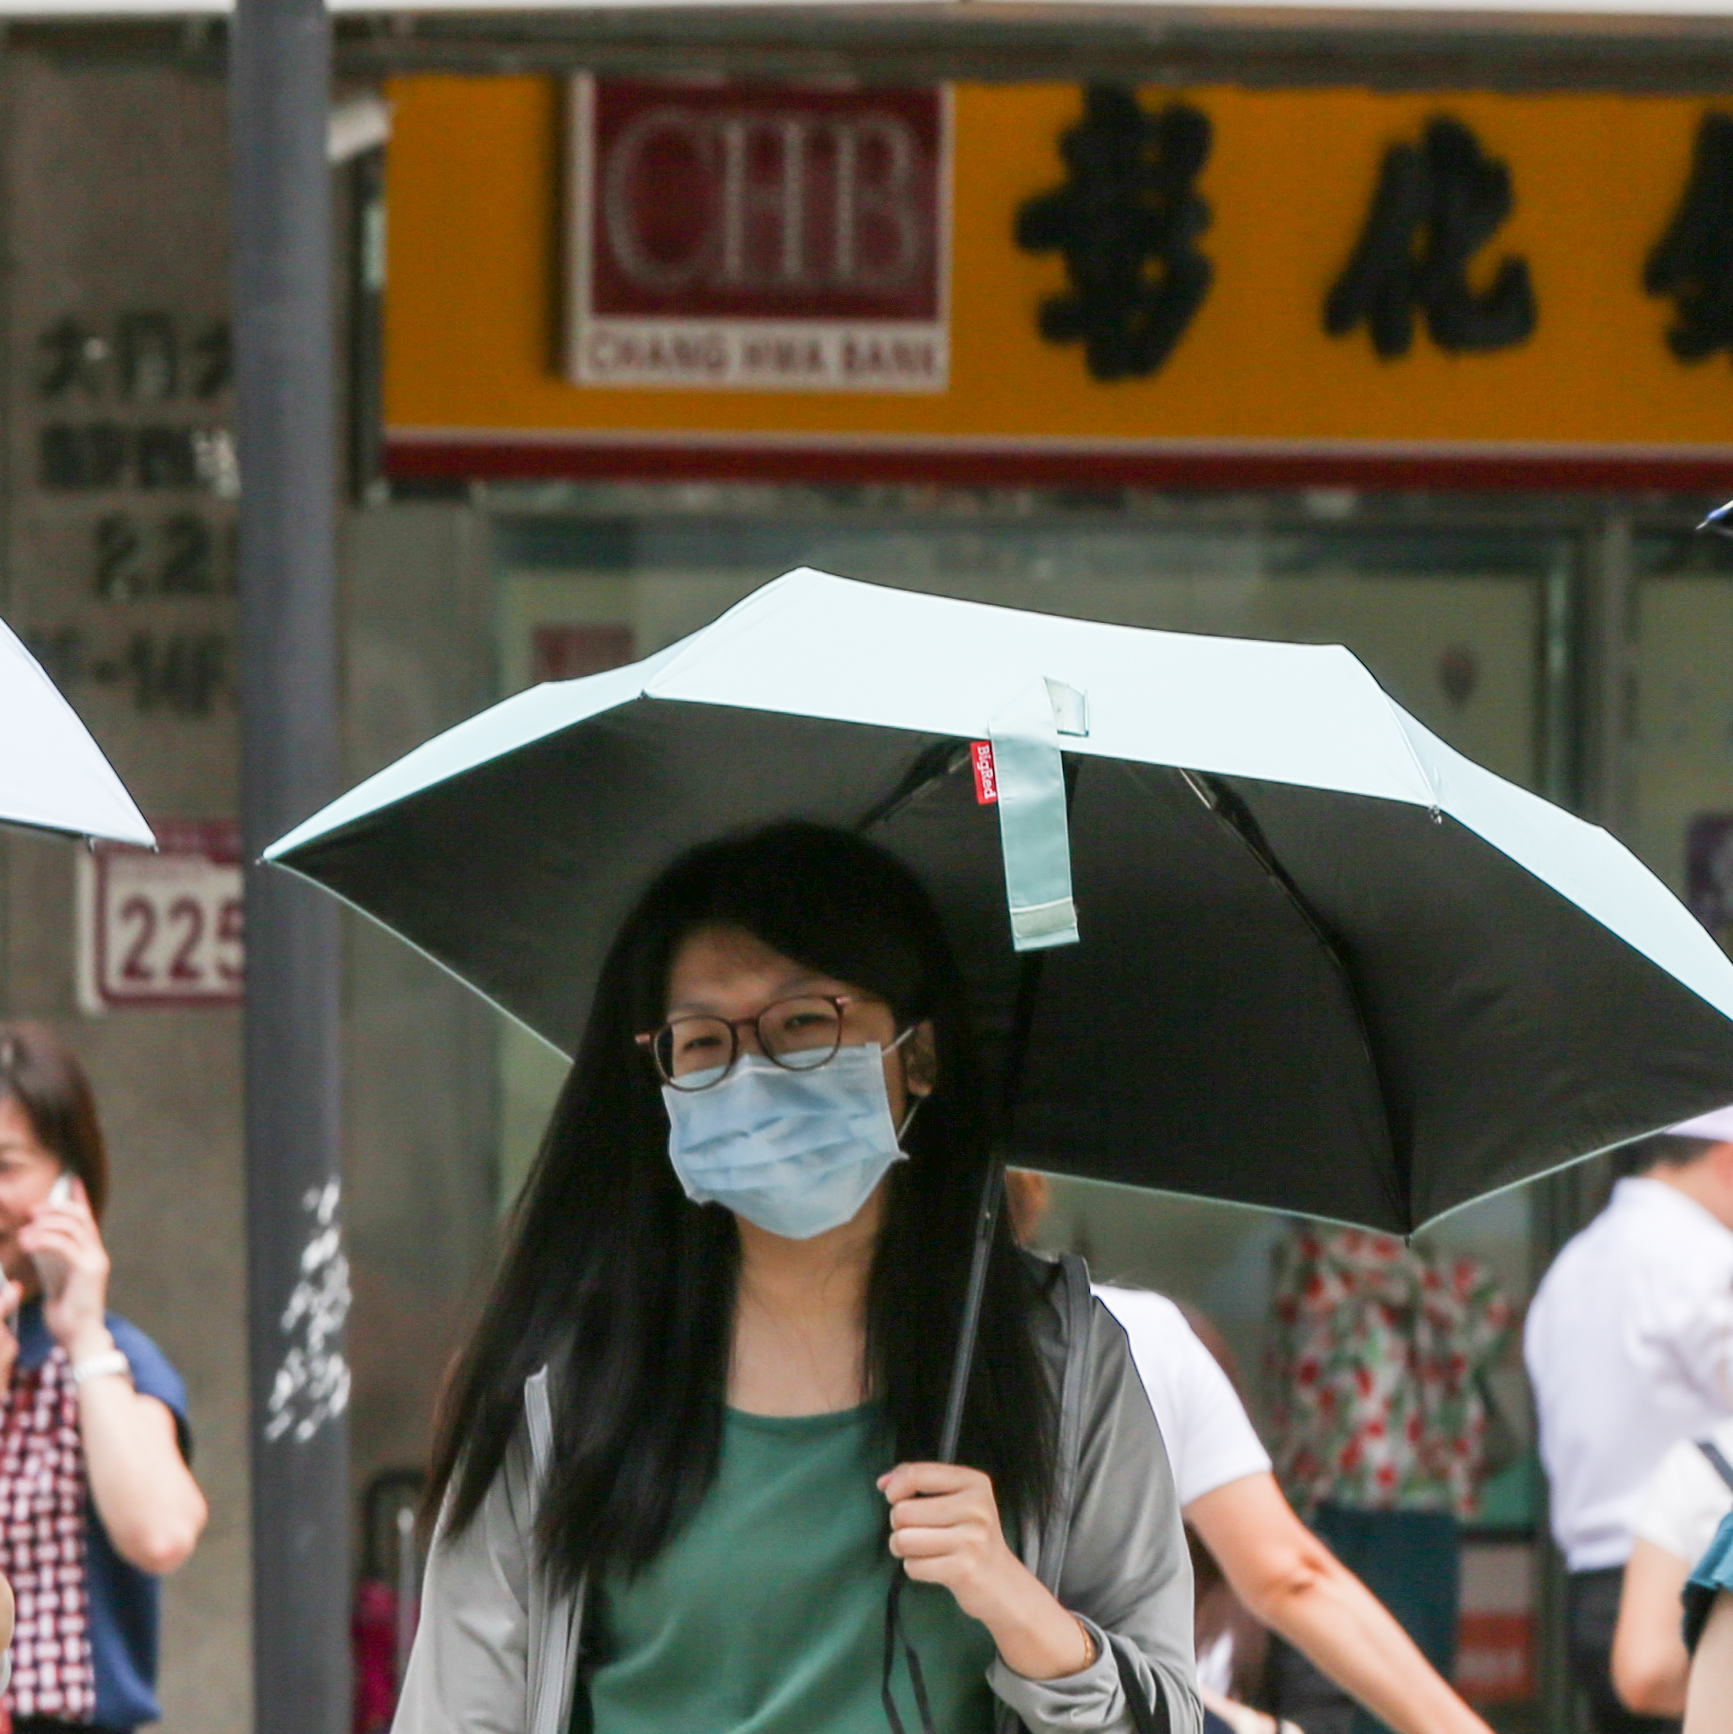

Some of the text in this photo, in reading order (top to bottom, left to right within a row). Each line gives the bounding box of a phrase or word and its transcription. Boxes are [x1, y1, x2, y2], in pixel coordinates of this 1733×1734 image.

[605, 107, 923, 290] CHB
[587, 329, 937, 378] CHANG HWA BANK
[977, 744, 996, 800] BigRed
[119, 895, 242, 980] 225
